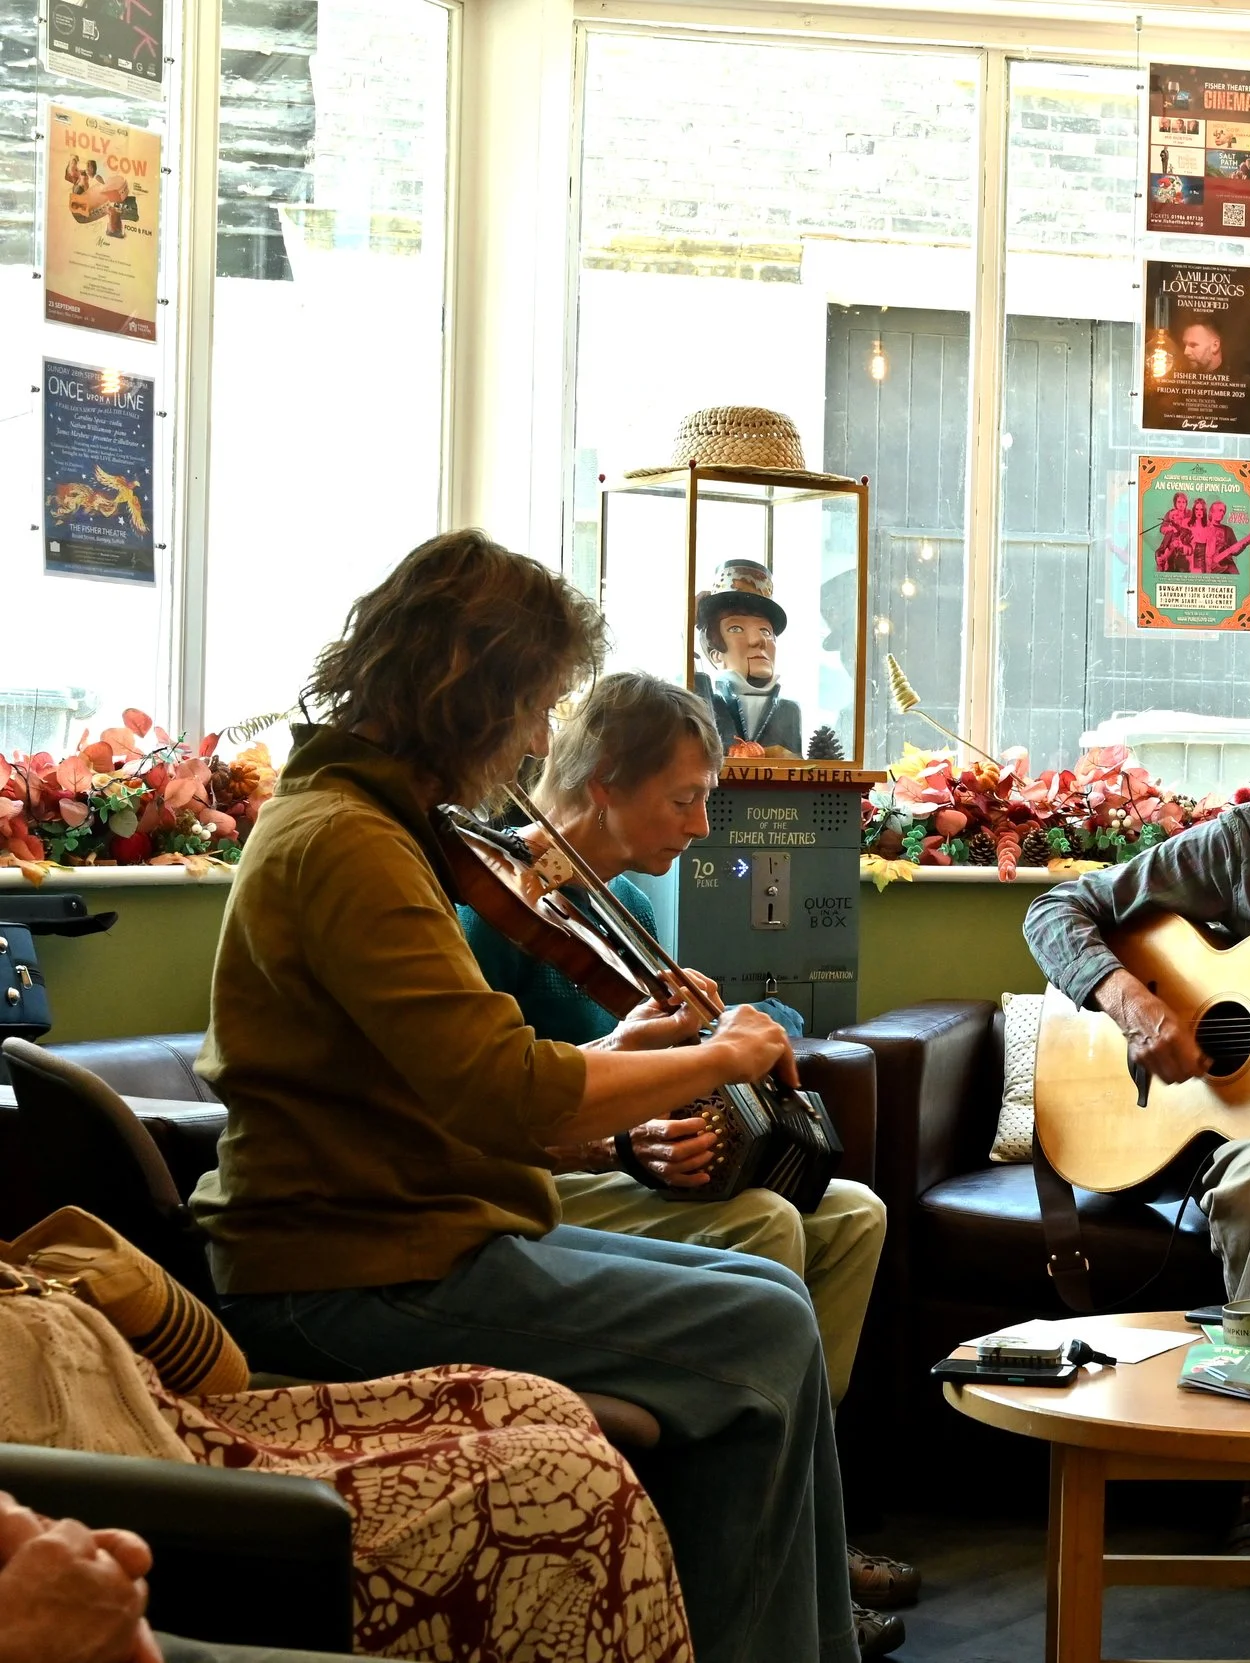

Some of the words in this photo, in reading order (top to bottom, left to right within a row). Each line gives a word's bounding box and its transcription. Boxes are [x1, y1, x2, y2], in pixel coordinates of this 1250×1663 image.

[65, 130, 110, 154] HOLY
[107, 155, 147, 176] COW
[125, 224, 137, 232] FOOD
[1176, 271, 1183, 281] A
[1184, 272, 1230, 284] MILLION
[1163, 280, 1198, 293] LOVE
[1200, 283, 1245, 297] SONGS
[55, 302, 80, 312] SEPTEMBER
[48, 365, 70, 374] SUNDAY
[1174, 372, 1197, 380] FISHER
[1198, 373, 1230, 381] THEATRE
[48, 376, 84, 401] ONCE
[86, 393, 104, 402] UPON
[1197, 389, 1231, 397] SEPTEMBER
[1155, 482, 1166, 490] AN
[1167, 482, 1194, 491] EVENING
[1196, 483, 1203, 492] OF
[1204, 484, 1220, 492] PINK
[1220, 484, 1240, 493] FLOYD
[82, 526, 101, 534] FISHER
[102, 528, 126, 538] THEATRE
[719, 768, 773, 780] AVID
[788, 769, 852, 782] FISHER
[747, 808, 798, 820] FOUNDER
[773, 822, 787, 830] THE
[729, 831, 765, 844] FISHER
[768, 832, 816, 844] THEATRES
[692, 858, 714, 879] 20
[696, 878, 719, 888] PENCE
[804, 898, 852, 911] QUOTE
[810, 916, 847, 928] BOX
